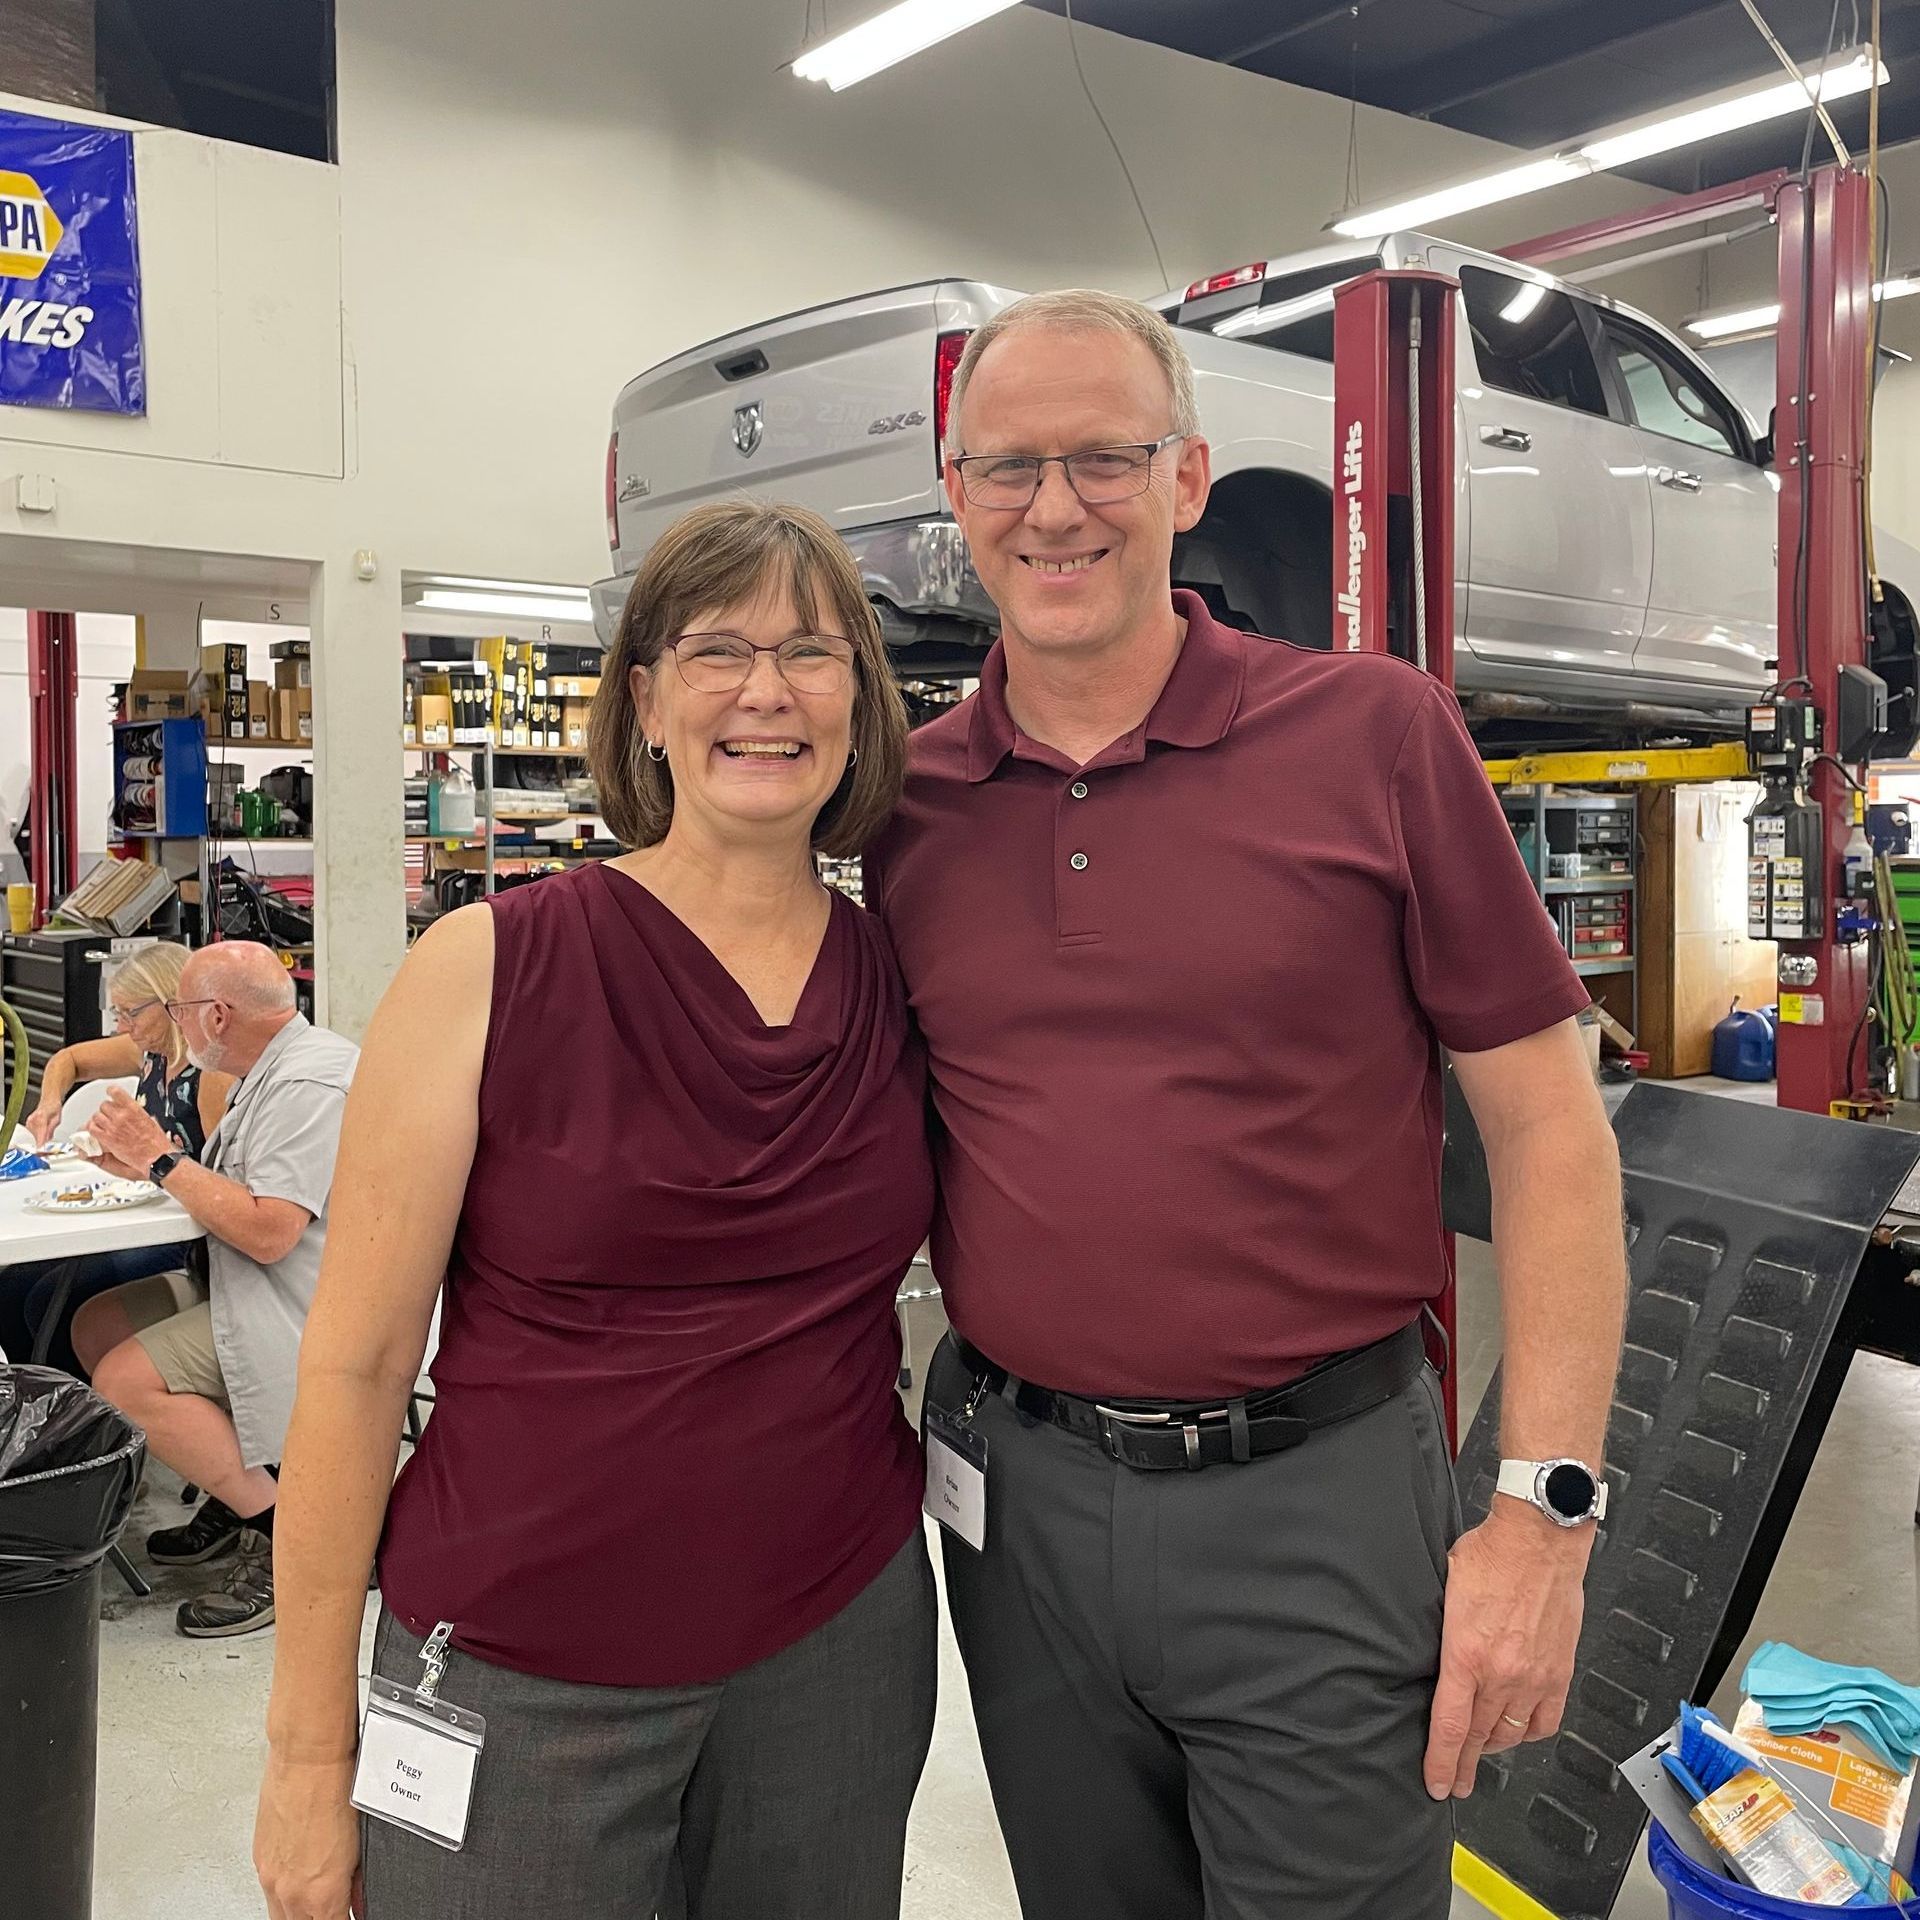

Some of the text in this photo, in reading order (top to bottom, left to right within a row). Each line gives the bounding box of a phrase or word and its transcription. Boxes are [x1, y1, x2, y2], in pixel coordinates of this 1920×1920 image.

[0, 297, 95, 349] KES
[1344, 420, 1363, 494] Lifts
[269, 603, 281, 621] S
[542, 624, 552, 640] R
[1790, 1745, 1823, 1763] Cloths
[396, 1758, 423, 1780] Peggy
[1849, 1759, 1878, 1777] Large
[390, 1781, 422, 1802] Owner
